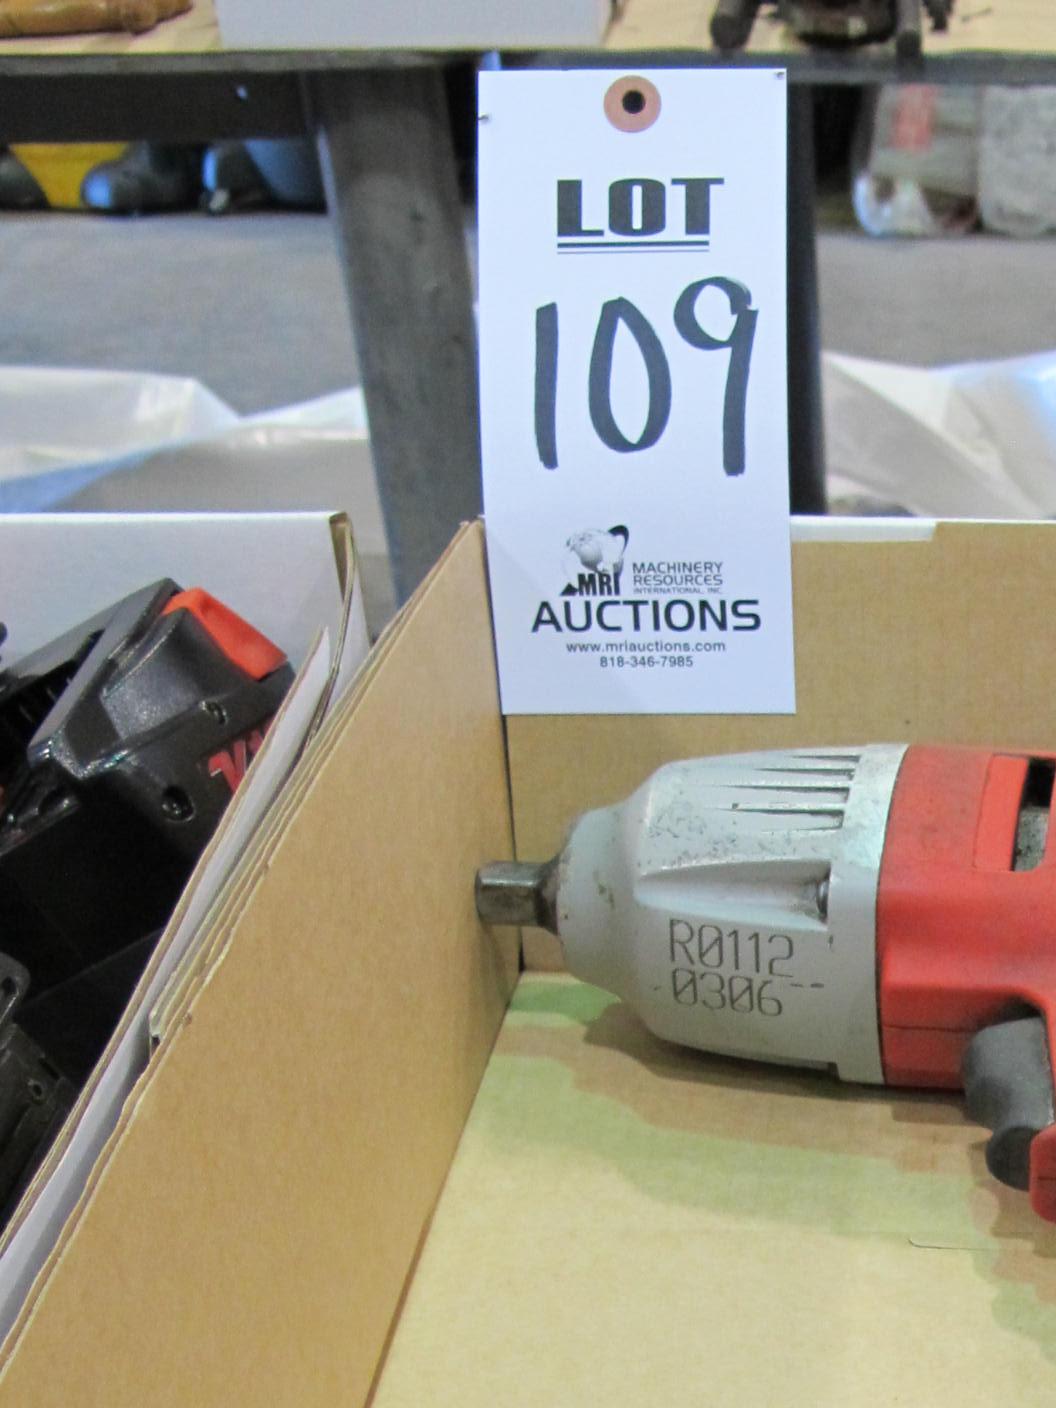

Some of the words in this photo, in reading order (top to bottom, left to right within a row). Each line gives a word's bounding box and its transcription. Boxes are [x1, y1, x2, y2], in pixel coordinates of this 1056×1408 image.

[557, 178, 724, 237] LOT
[534, 276, 758, 477] 109
[633, 562, 723, 574] MACHINERY
[633, 574, 723, 587] RESOURCES
[576, 572, 621, 597] MRI
[531, 599, 762, 633] AUCTIONS
[566, 640, 726, 653] www.mriauctions.com
[600, 656, 693, 668] 818-346-7985
[669, 918, 795, 978] R0112
